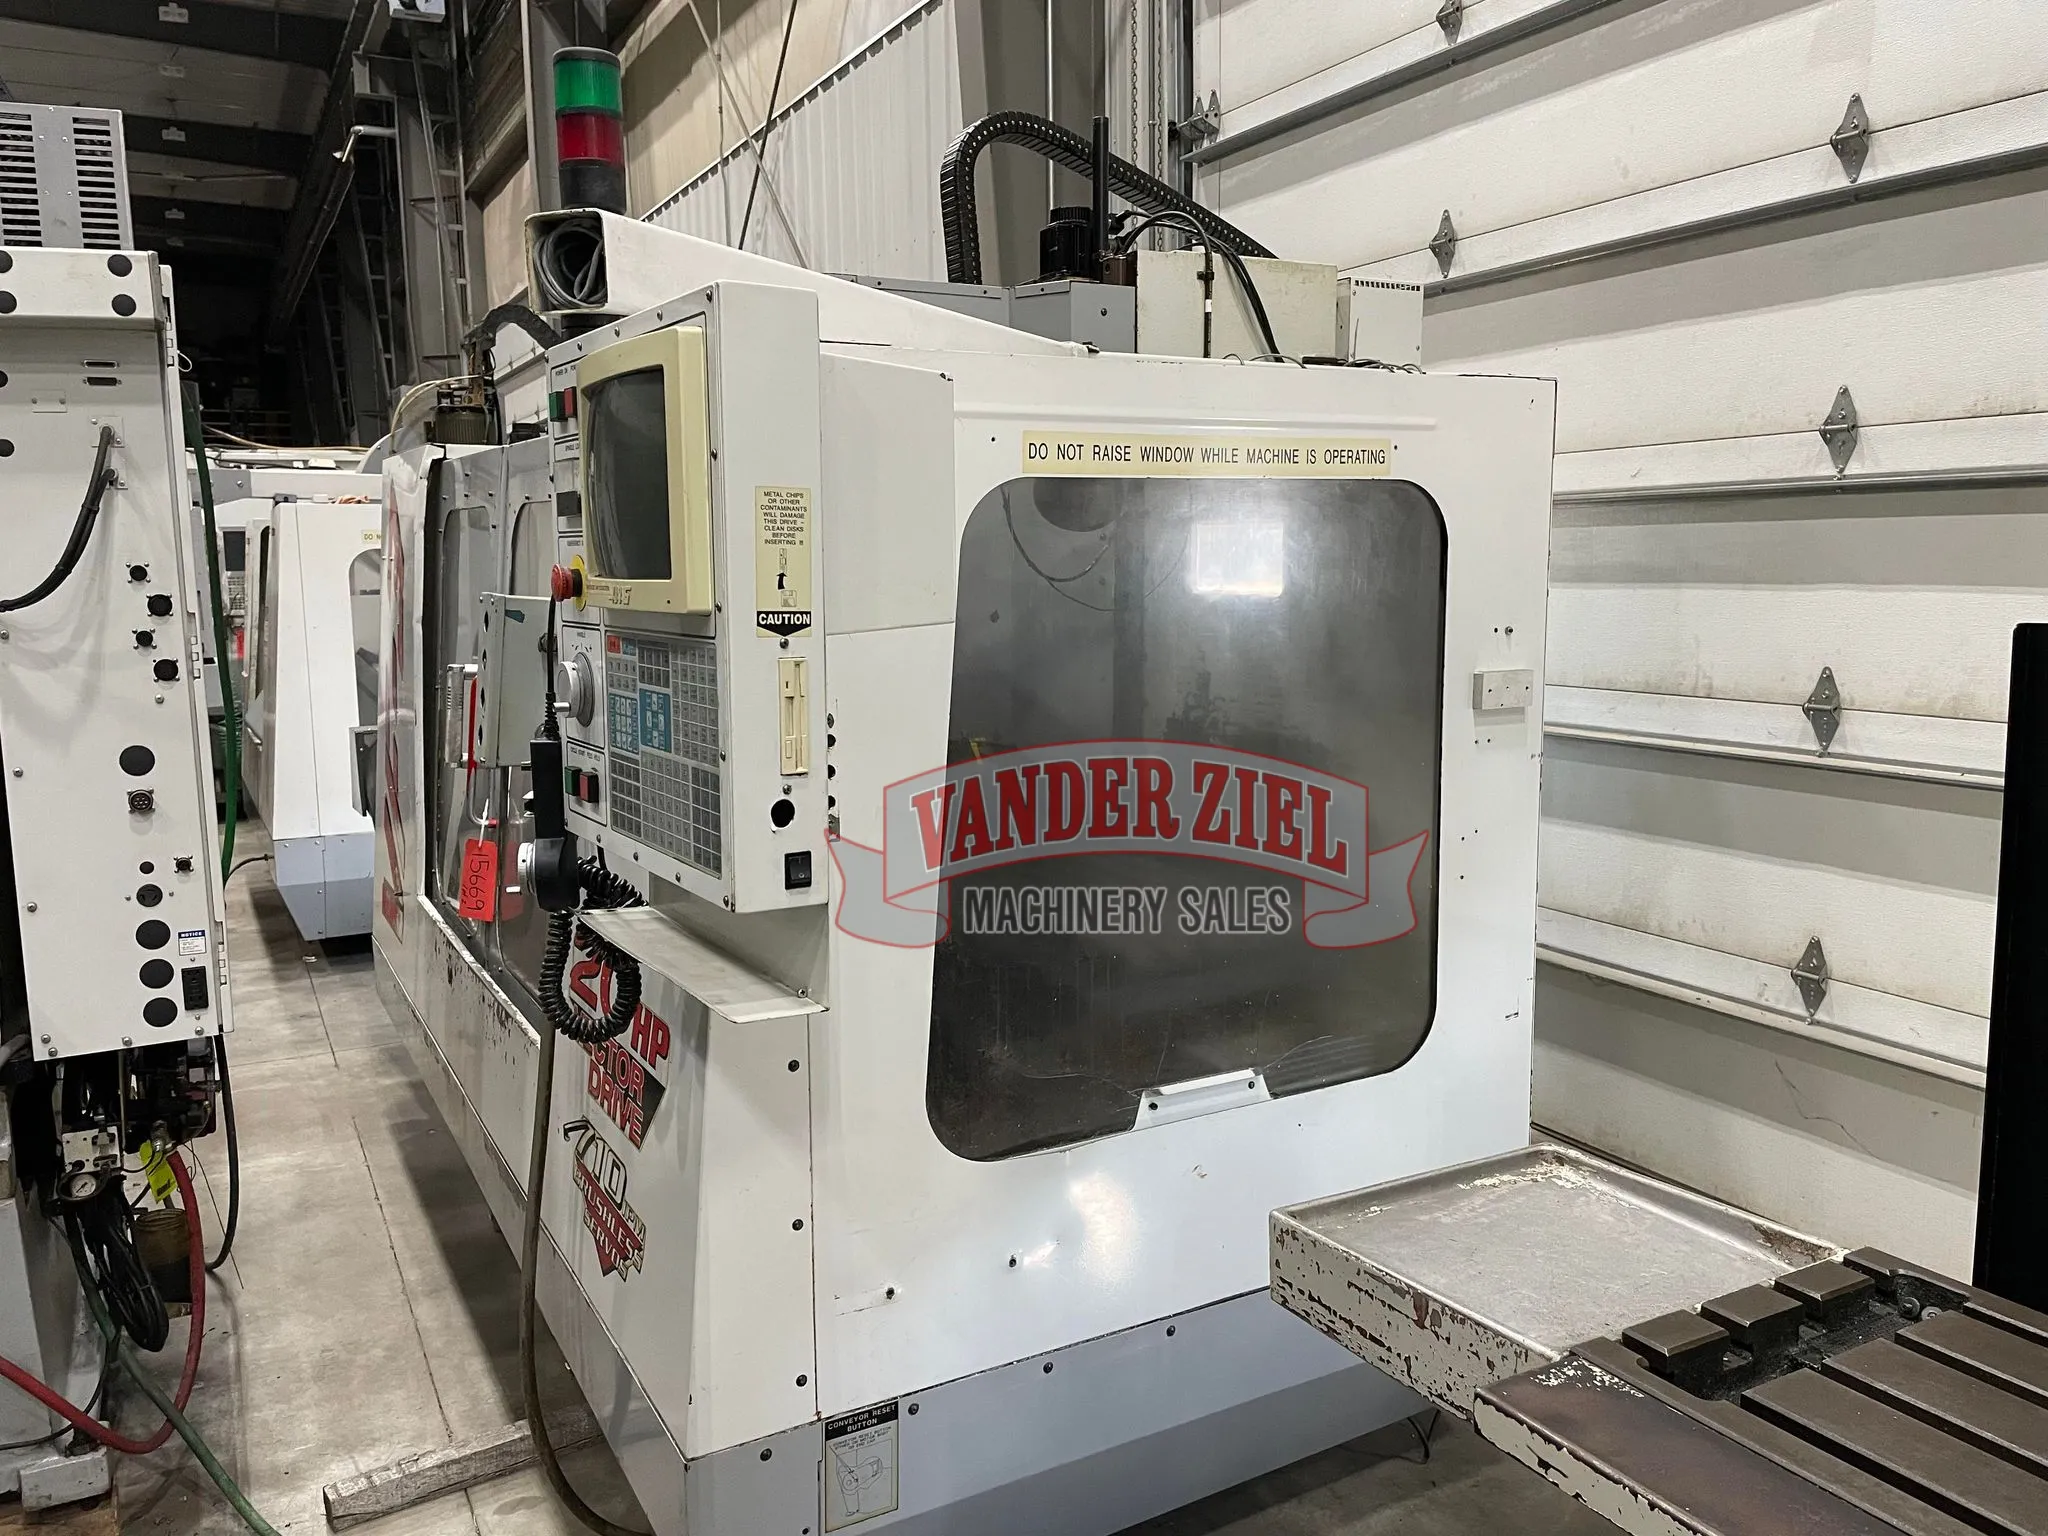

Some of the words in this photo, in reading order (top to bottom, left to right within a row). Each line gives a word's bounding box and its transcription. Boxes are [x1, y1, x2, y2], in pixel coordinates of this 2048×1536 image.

[1028, 442, 1048, 460] DO
[1057, 443, 1084, 461] NOT
[1092, 444, 1131, 462] RAISE
[1140, 446, 1194, 463] WINDOW
[1200, 447, 1239, 464] WHILE
[1247, 448, 1299, 465] MACHINE
[1306, 449, 1317, 465] IS
[1324, 449, 1386, 465] OPERATING
[760, 504, 808, 512] CONTAMINANTS
[758, 613, 810, 625] CAUTION
[466, 853, 490, 911] 15669
[630, 1003, 671, 1072] HP
[588, 1057, 645, 1151] DRIVE
[563, 1119, 628, 1211] 710
[573, 1166, 645, 1274] BRUSHLESS
[583, 1208, 628, 1283] SERVOS
[827, 1412, 869, 1430] CONVEYOR
[872, 1404, 896, 1417] RESET
[847, 1417, 878, 1432] BUTTON
